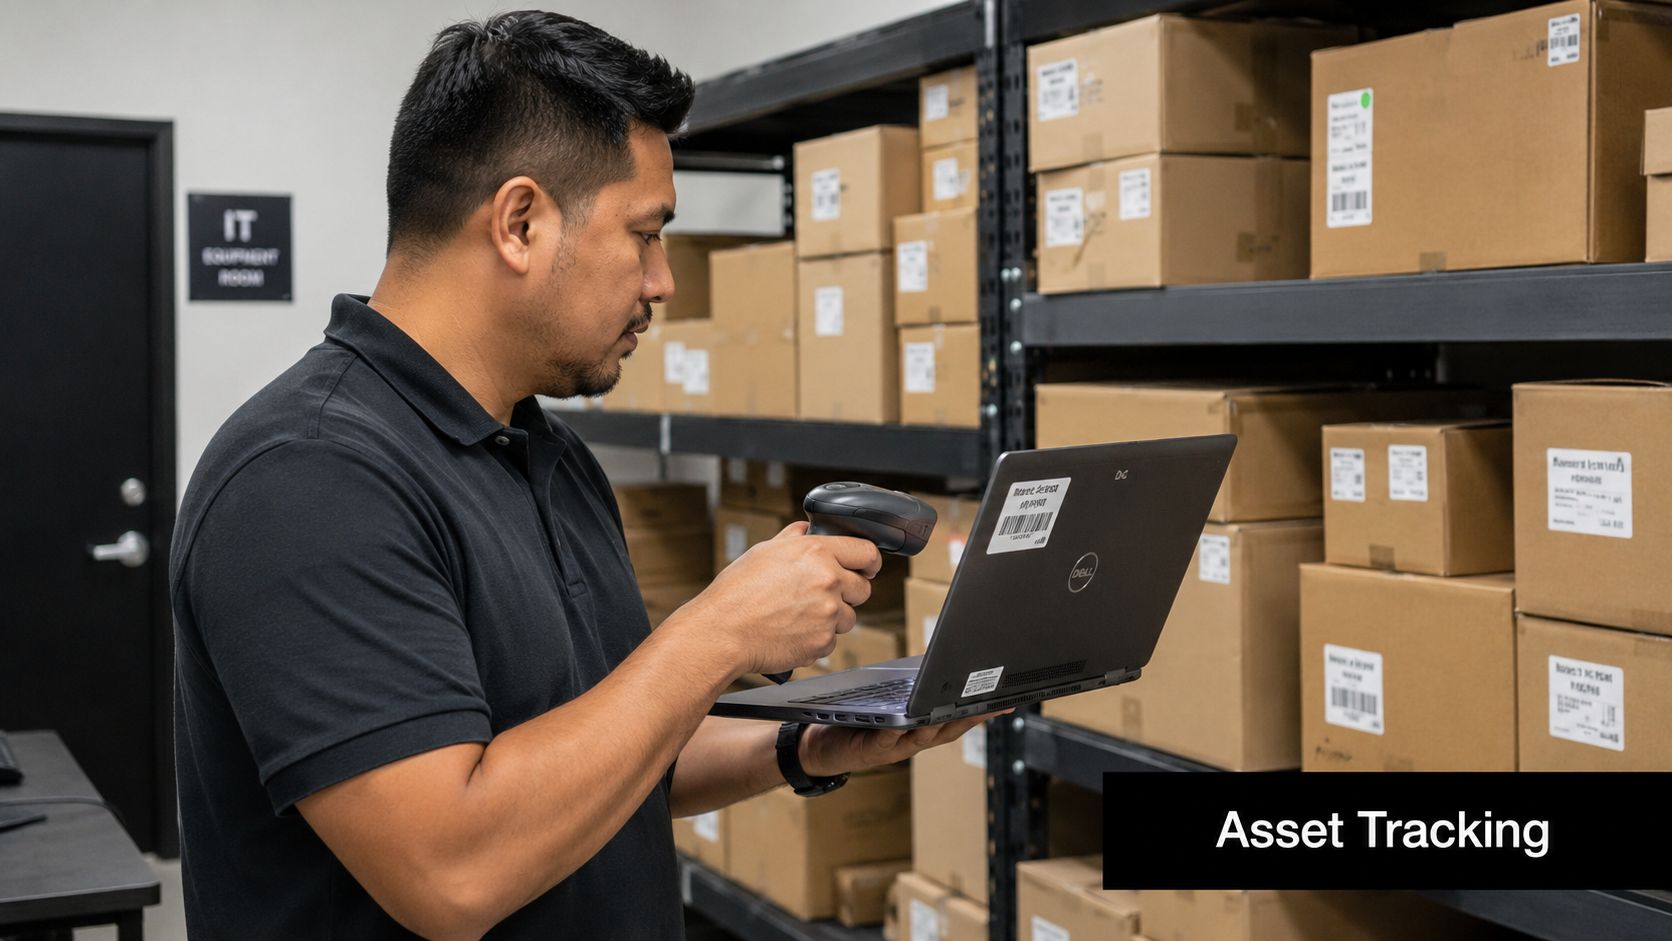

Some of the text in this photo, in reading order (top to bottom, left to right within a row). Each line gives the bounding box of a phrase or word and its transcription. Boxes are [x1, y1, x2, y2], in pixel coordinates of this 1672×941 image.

[223, 209, 259, 242] IT
[217, 268, 265, 287] ROOM
[1072, 567, 1094, 579] DELL
